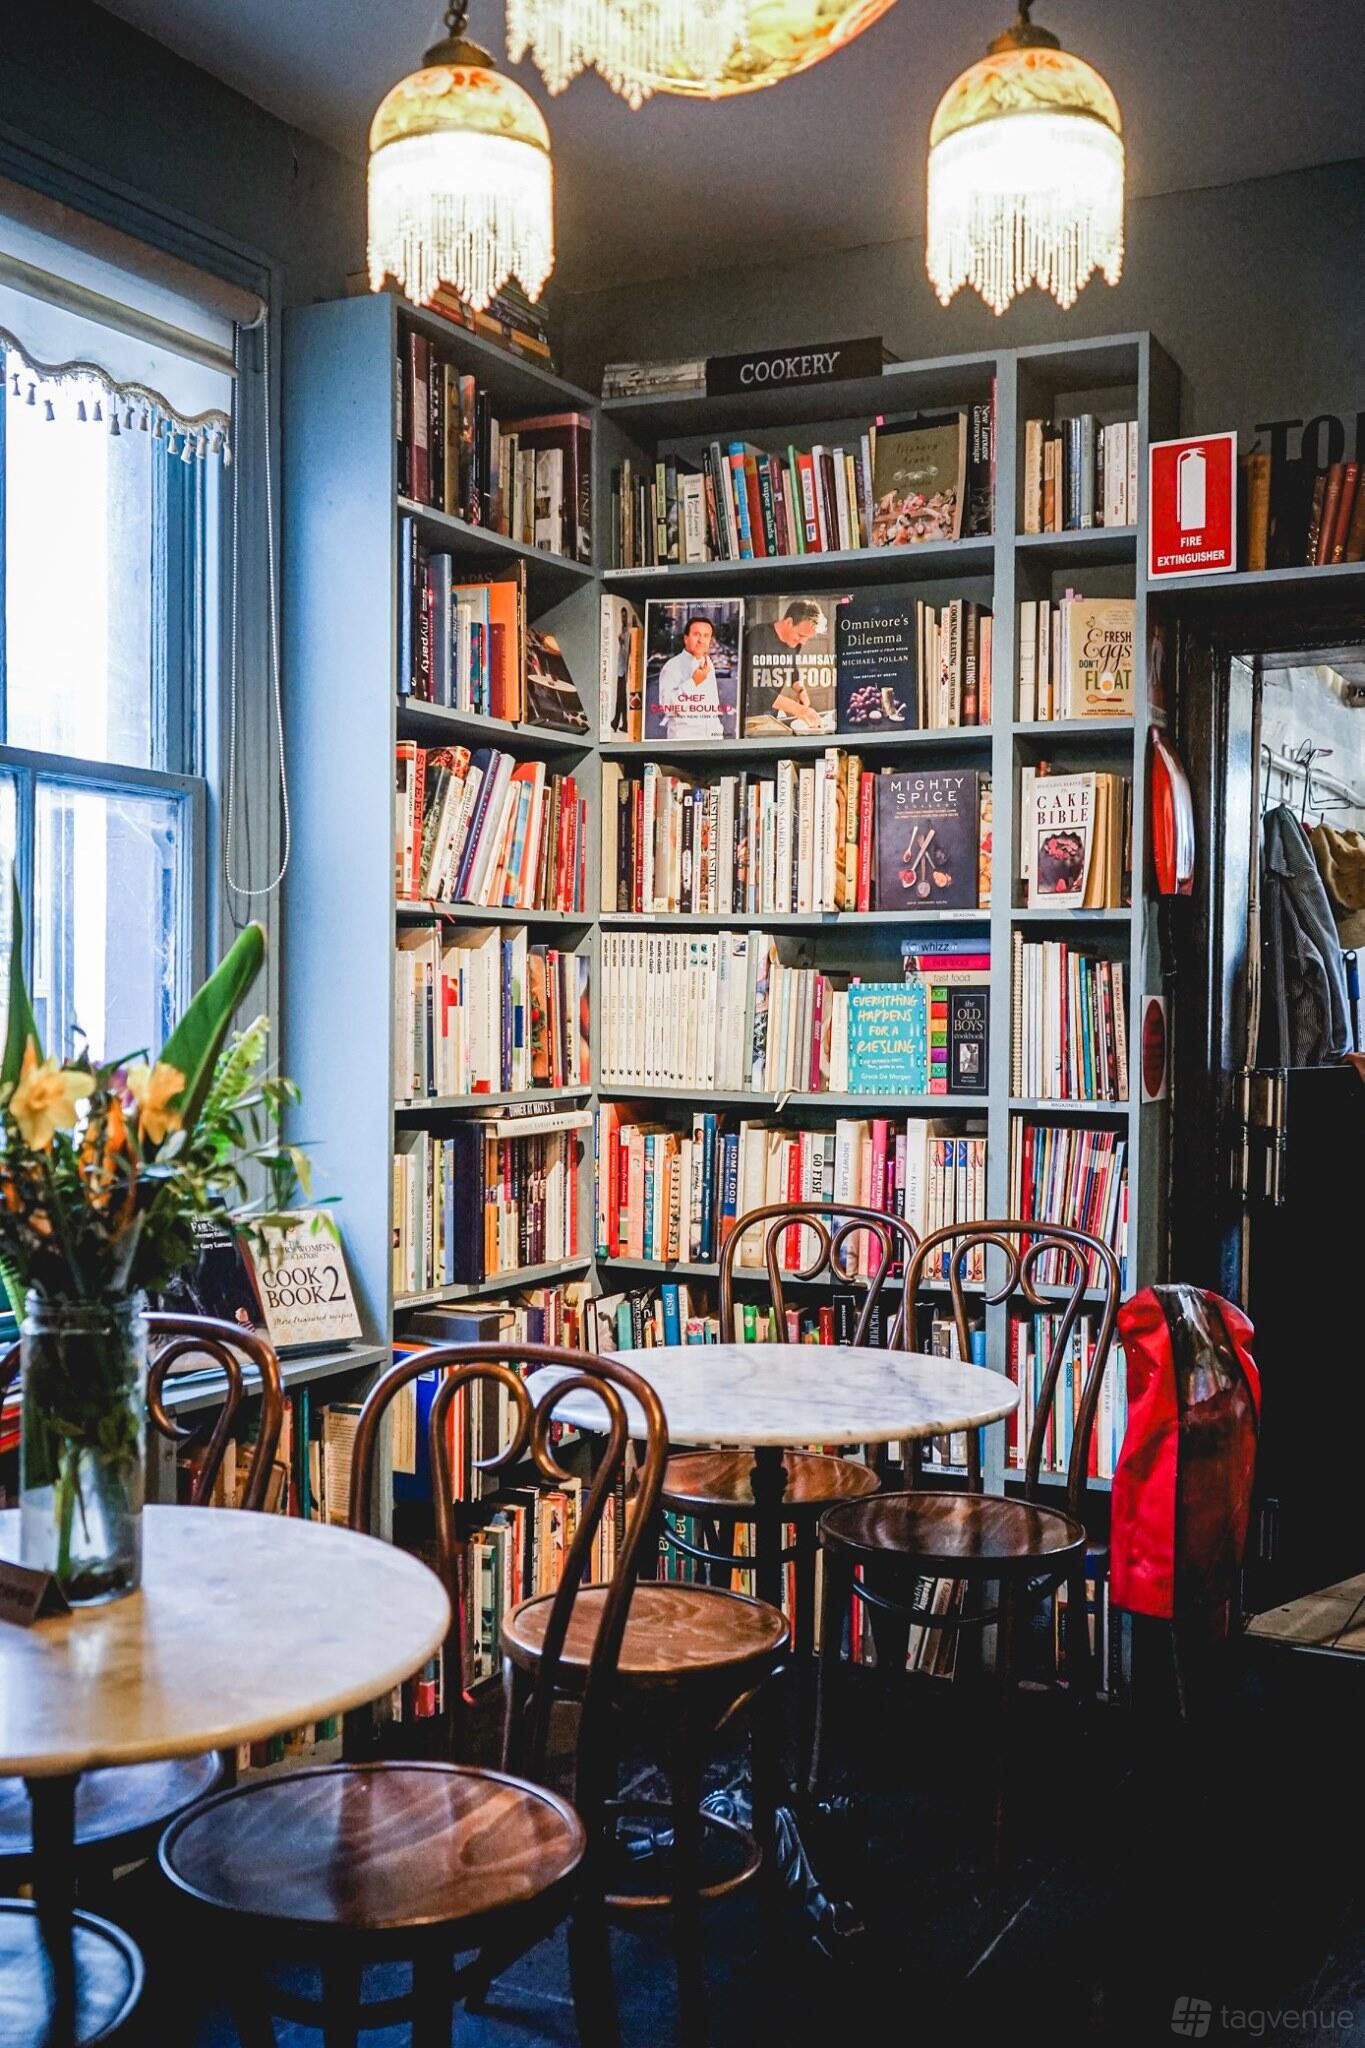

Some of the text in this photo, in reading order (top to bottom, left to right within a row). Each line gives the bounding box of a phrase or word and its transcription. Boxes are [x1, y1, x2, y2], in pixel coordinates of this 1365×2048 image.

[740, 351, 841, 384] COOKERY
[762, 482, 774, 539] super salads
[1180, 536, 1202, 548] FIRE
[1157, 550, 1225, 568] EXTINGUISHER
[841, 613, 909, 631] Omnivore's
[847, 633, 902, 647] Dilemma
[1104, 630, 1132, 643] FRESH
[1083, 628, 1132, 672] Eggs
[752, 654, 836, 666] GORDON RAMSAY'
[842, 655, 908, 666] MICHAEL POLLAN
[1079, 660, 1099, 668] DON'T
[752, 669, 794, 687] FAST
[678, 694, 705, 702] CHEF
[414, 753, 425, 828] SWEET
[890, 777, 964, 792] MIGHTY
[896, 790, 958, 804] SPICE
[1036, 791, 1090, 809] CAKE
[1037, 808, 1088, 826] BIBLE
[921, 941, 950, 952] whizz
[933, 974, 971, 982] fast food
[853, 994, 918, 1007] EVERYTHING
[858, 1008, 912, 1024] HAPPENS
[957, 1008, 982, 1020] OLD
[868, 1025, 899, 1037] FOR A
[812, 1153, 822, 1194] GO FISH
[841, 1142, 850, 1198] SNOWFLAKES
[729, 1177, 737, 1204] FOOD
[298, 1244, 336, 1253] WOMEN'S
[263, 1266, 346, 1302] COOK 2
[266, 1286, 326, 1308] BOOK
